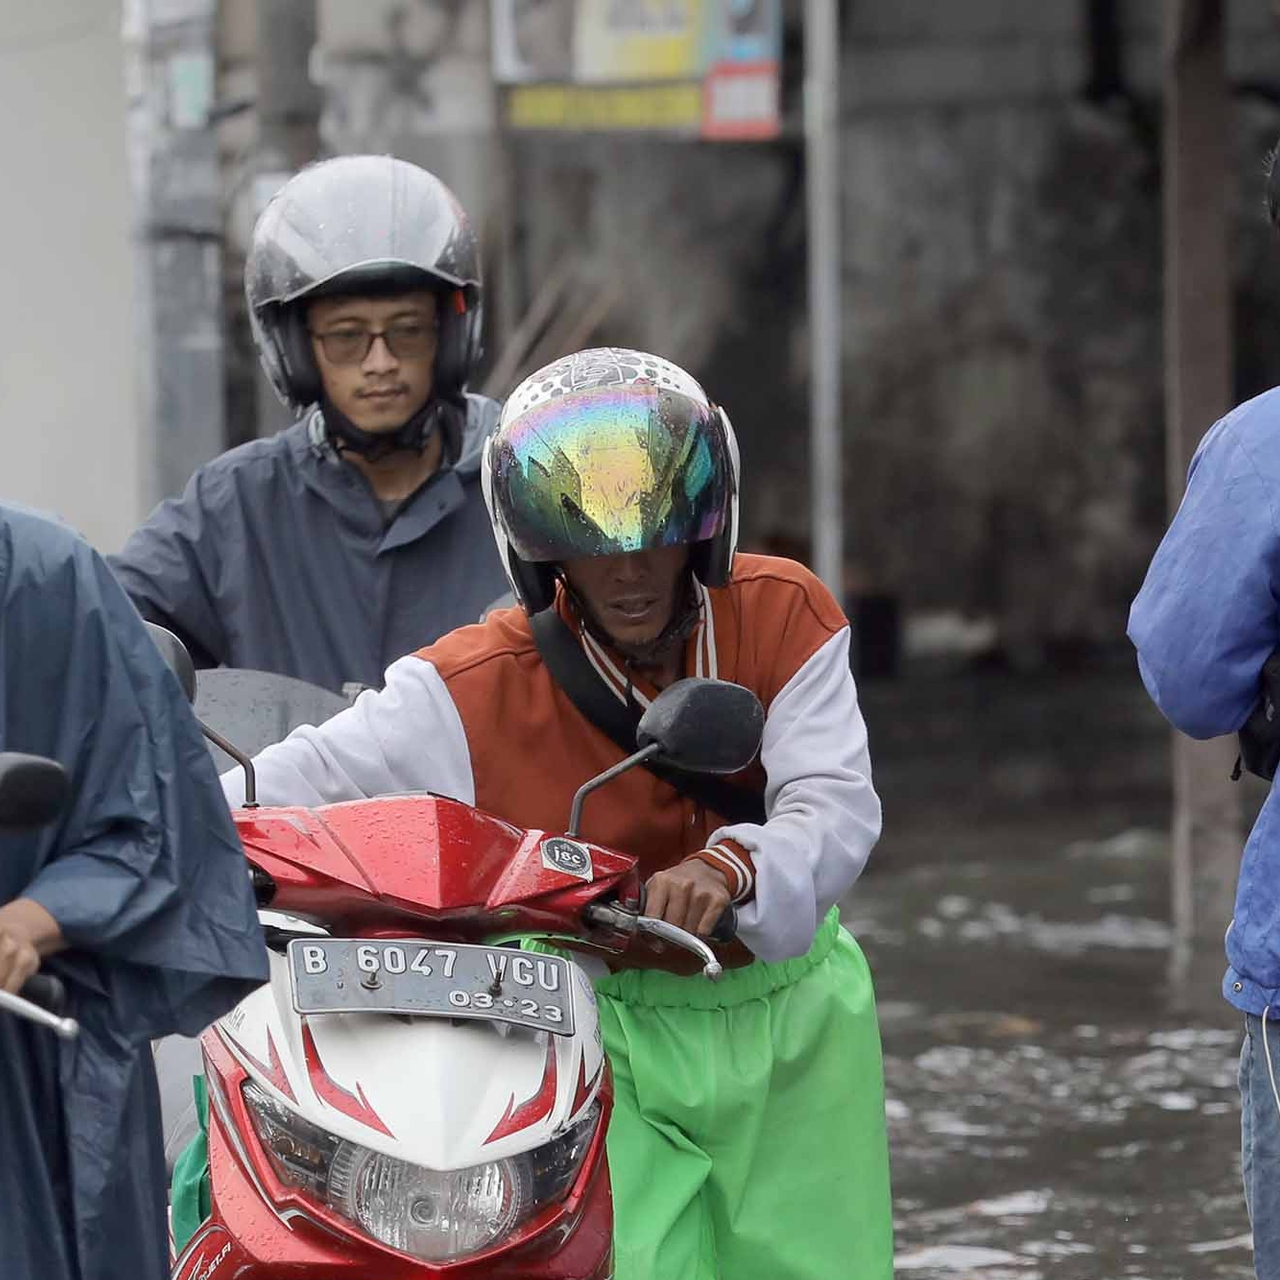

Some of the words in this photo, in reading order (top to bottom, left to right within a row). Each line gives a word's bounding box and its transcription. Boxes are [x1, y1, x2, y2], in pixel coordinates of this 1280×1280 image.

[303, 946, 327, 974] B
[357, 946, 457, 978] 6047
[486, 953, 559, 991] VGU
